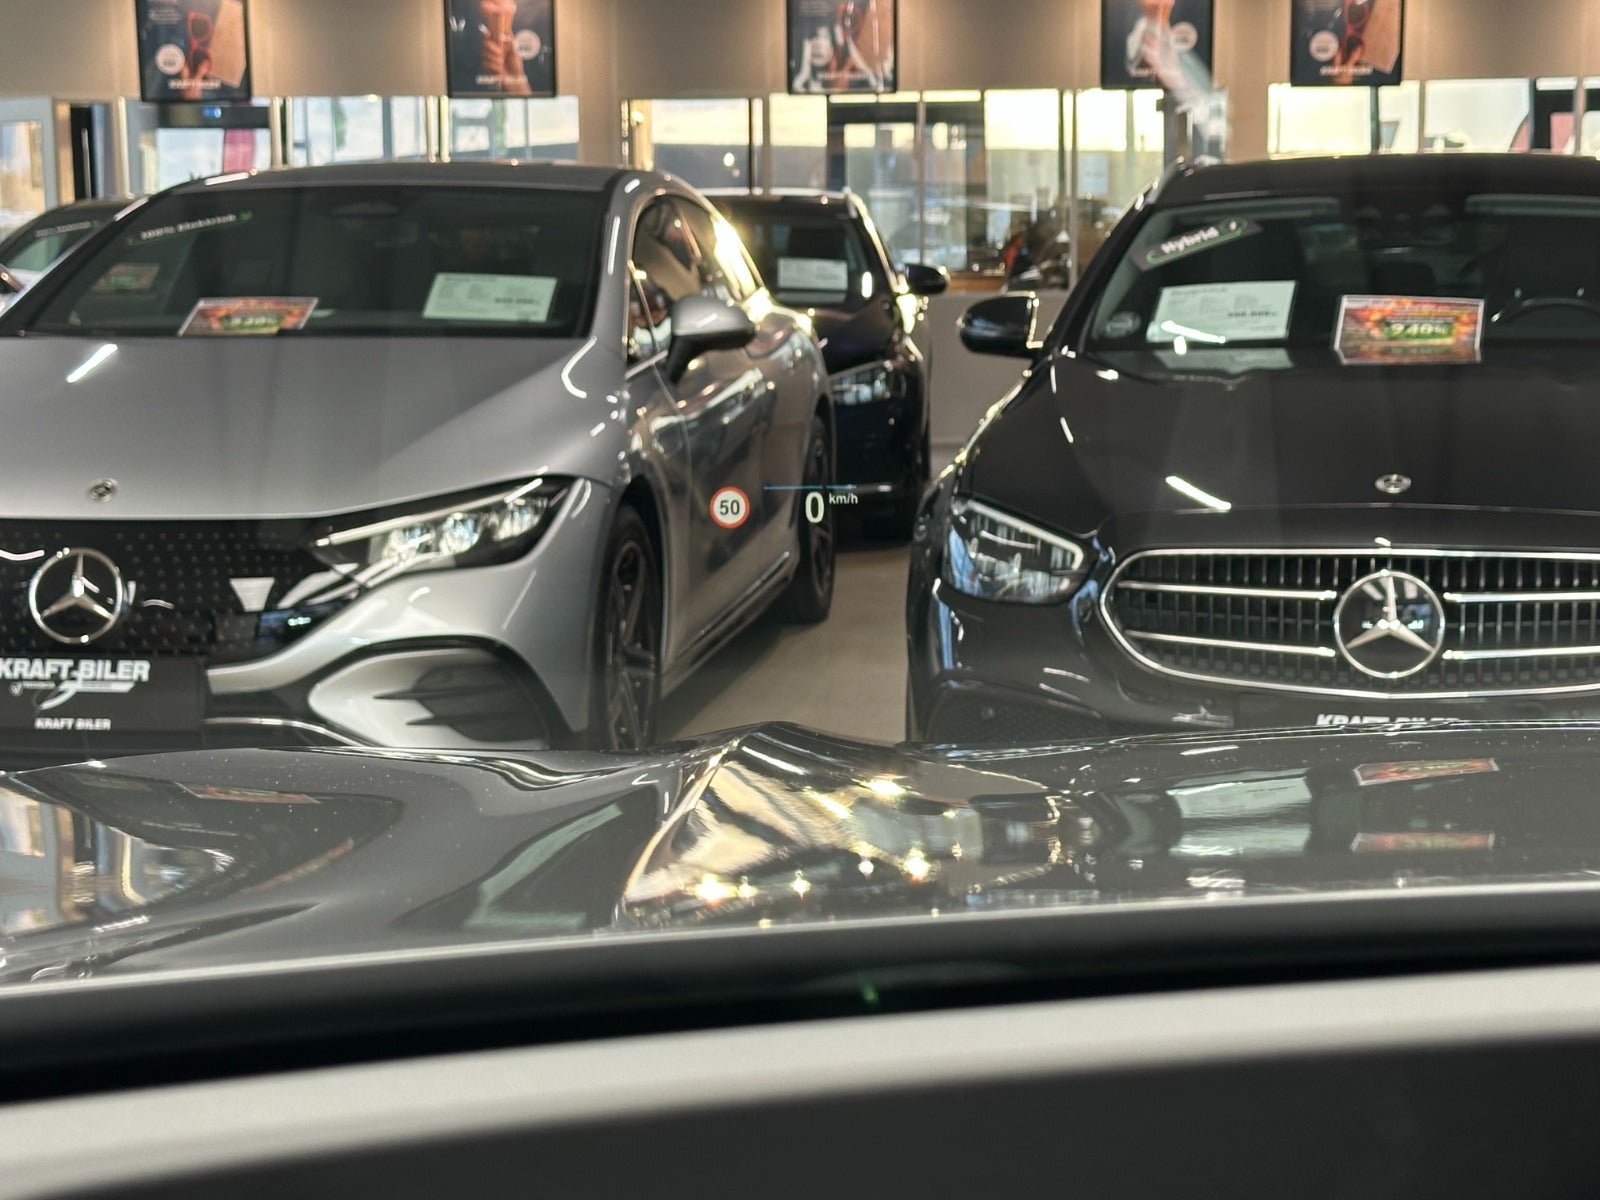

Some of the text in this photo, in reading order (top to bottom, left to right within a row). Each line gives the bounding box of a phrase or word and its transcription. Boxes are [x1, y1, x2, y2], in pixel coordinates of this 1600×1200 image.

[1161, 226, 1219, 254] Hybrid
[719, 499, 740, 516] 50
[805, 491, 858, 524] 0 km/h
[0, 657, 150, 682] KRAFT BILER
[34, 717, 111, 731] KRAFT BILER
